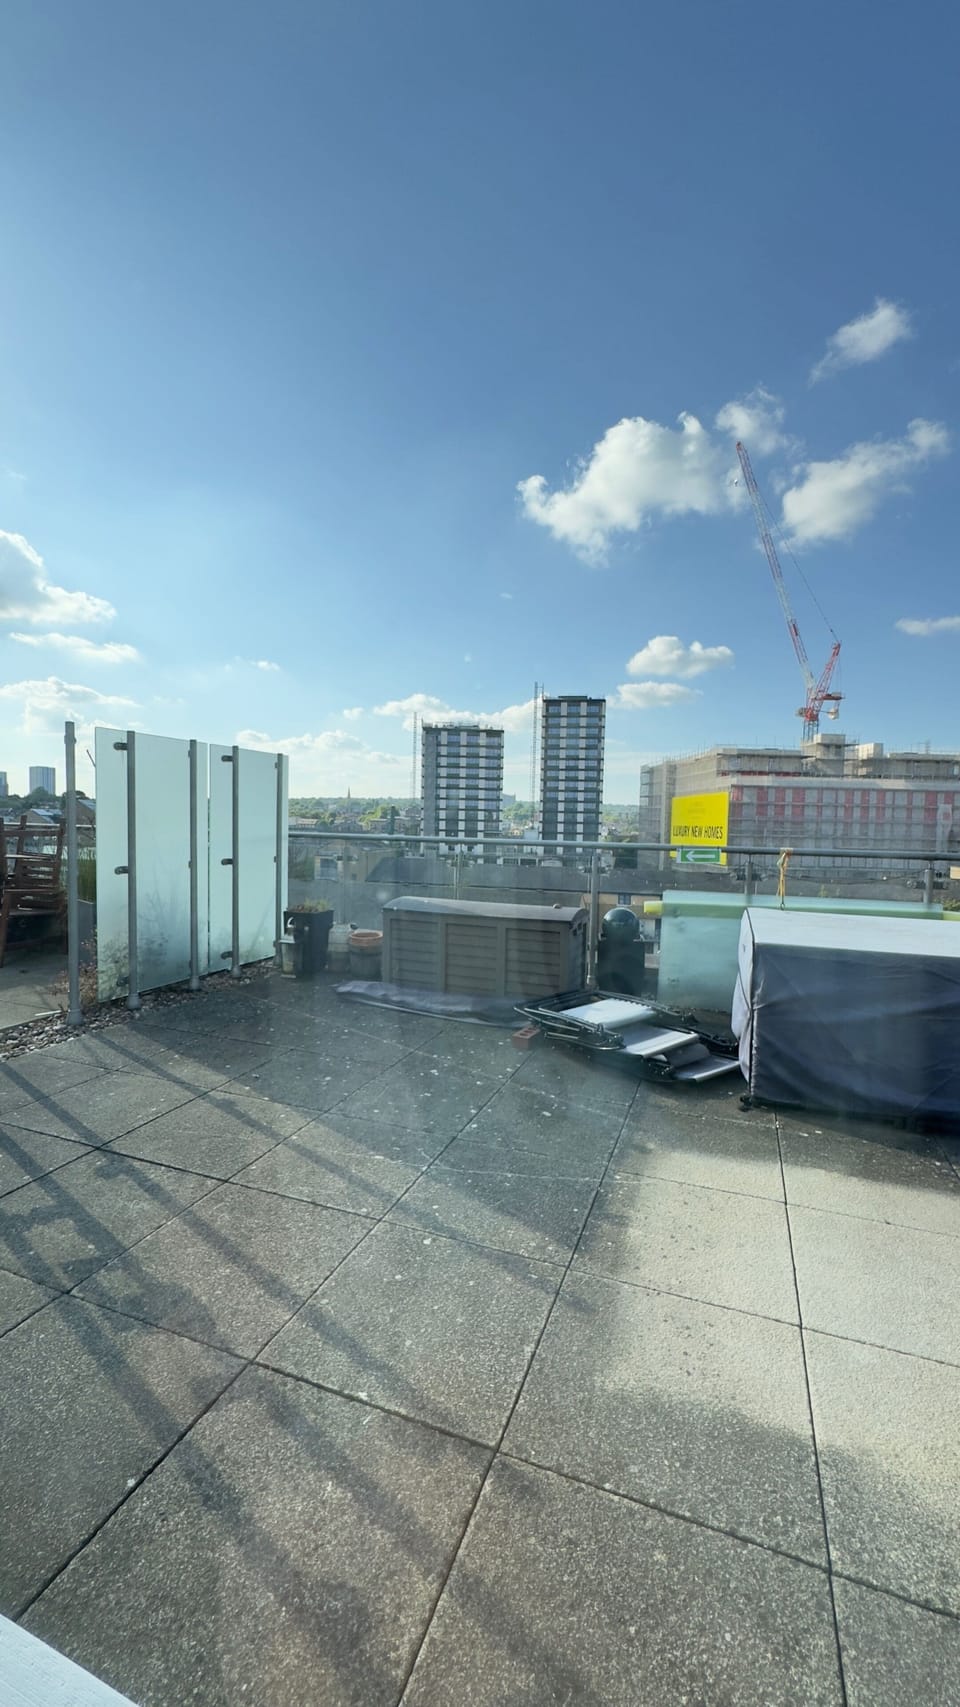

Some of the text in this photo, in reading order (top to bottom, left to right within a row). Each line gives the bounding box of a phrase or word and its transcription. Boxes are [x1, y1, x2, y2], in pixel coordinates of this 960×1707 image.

[672, 825, 723, 839] LUXURY NEW HOMES
